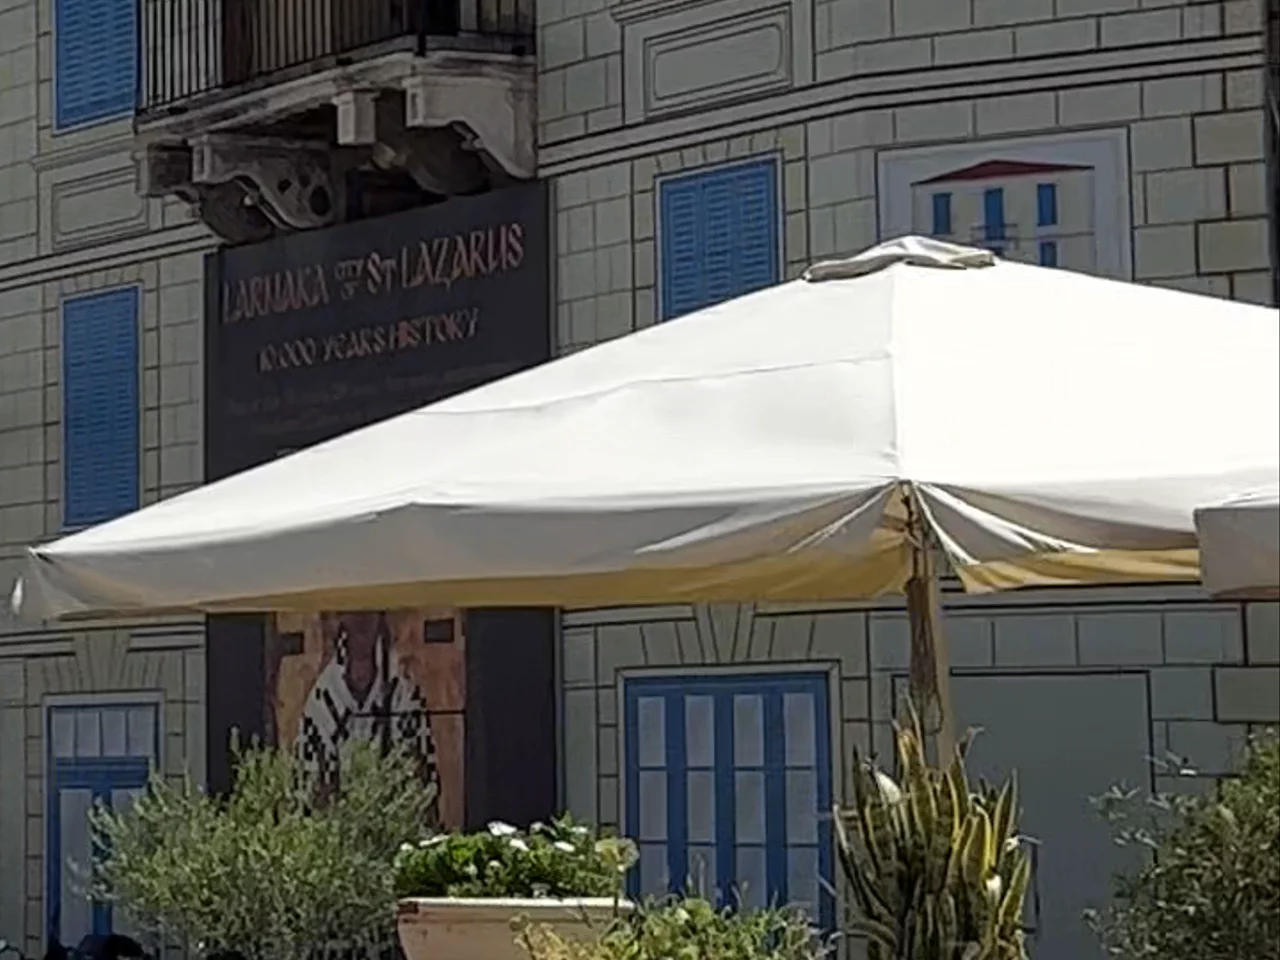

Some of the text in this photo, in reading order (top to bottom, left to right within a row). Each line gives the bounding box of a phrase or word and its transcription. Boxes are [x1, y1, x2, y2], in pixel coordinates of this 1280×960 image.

[401, 222, 526, 290] LAZARUS
[324, 323, 386, 363] YEARS
[389, 306, 480, 350] HISTORY
